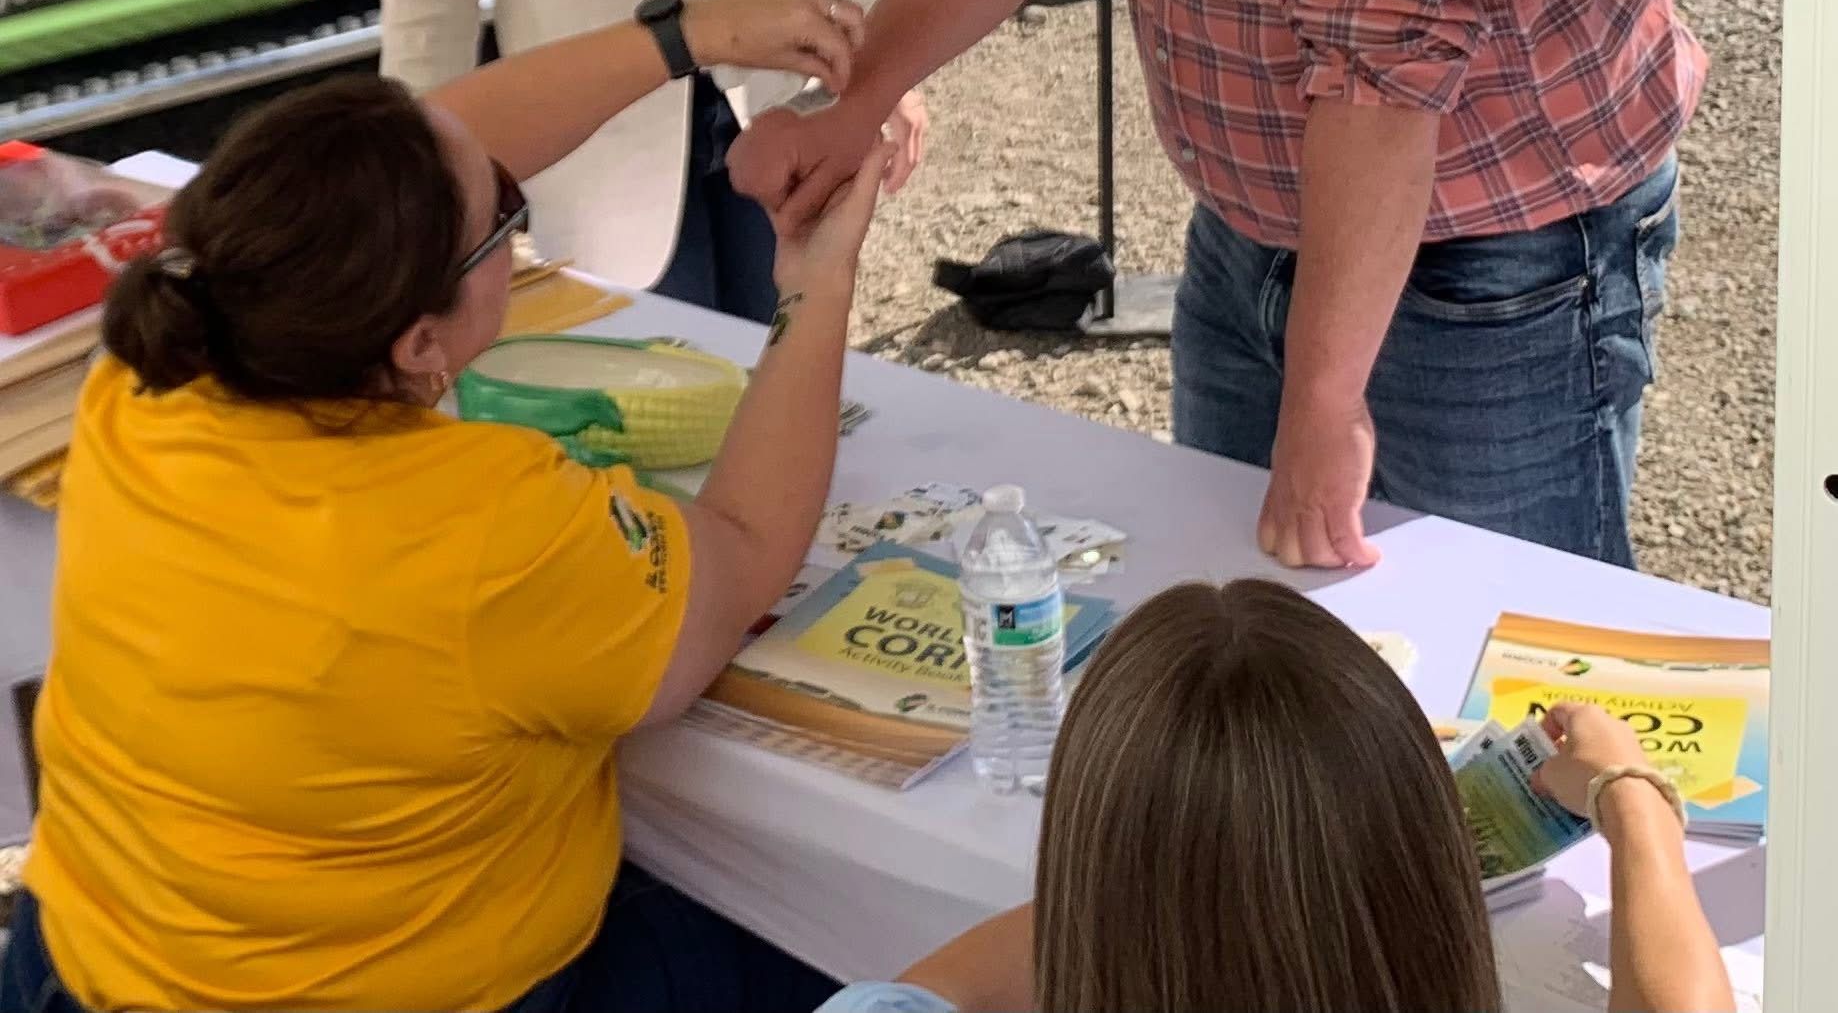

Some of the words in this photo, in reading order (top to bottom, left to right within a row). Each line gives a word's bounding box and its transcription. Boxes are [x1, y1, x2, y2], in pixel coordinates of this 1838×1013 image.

[864, 605, 965, 645] WORL
[838, 646, 912, 674] Activity
[1607, 697, 1695, 712] Activity
